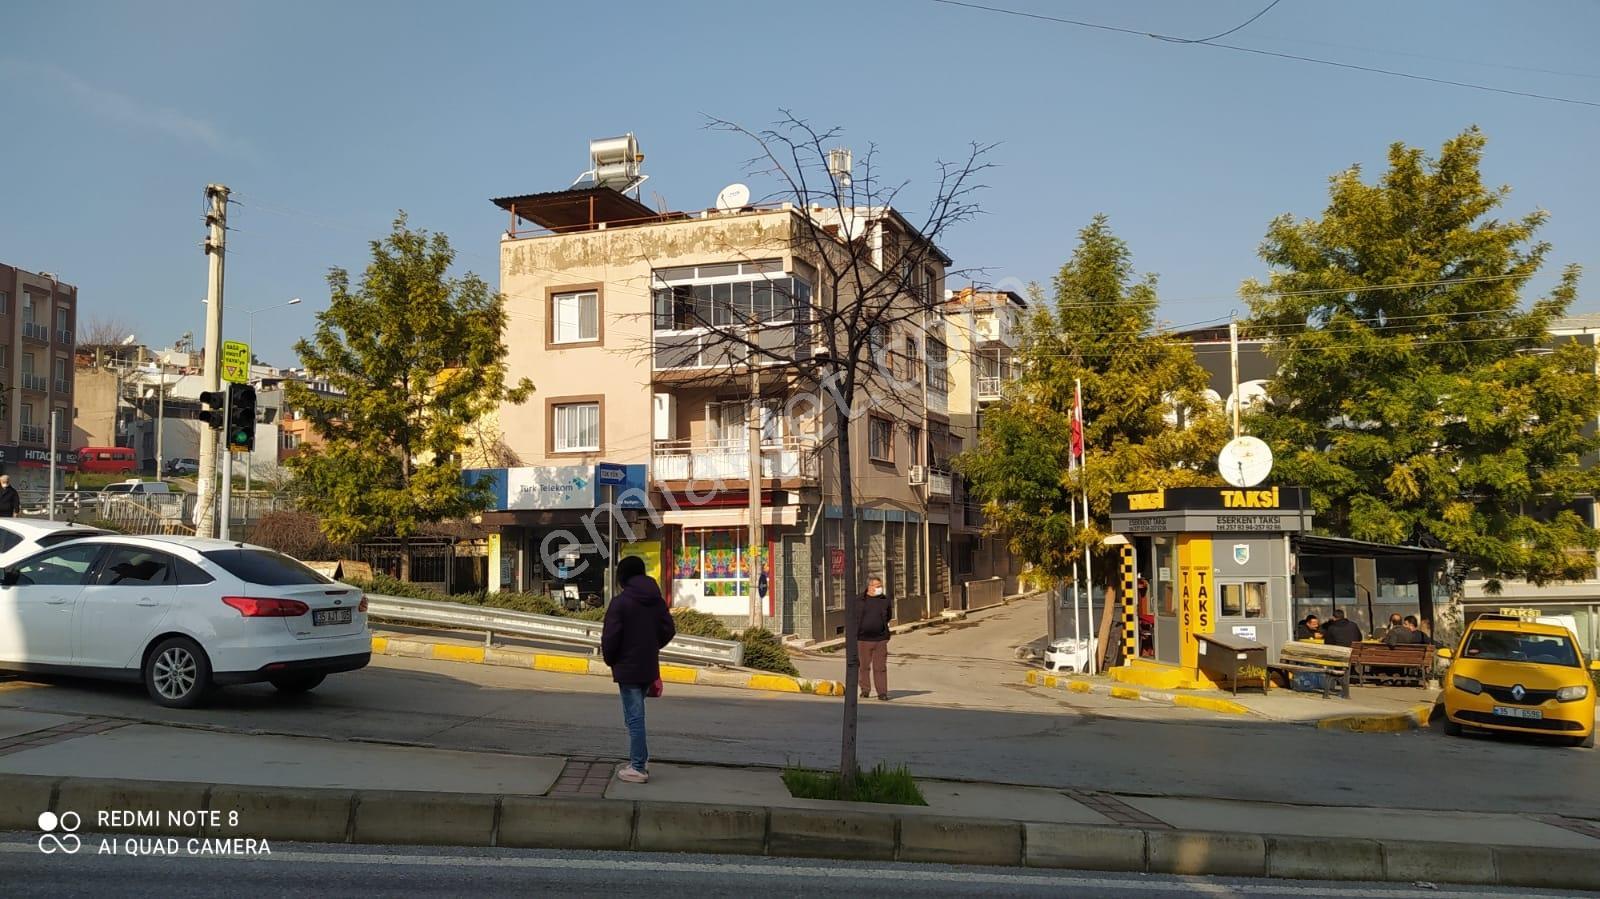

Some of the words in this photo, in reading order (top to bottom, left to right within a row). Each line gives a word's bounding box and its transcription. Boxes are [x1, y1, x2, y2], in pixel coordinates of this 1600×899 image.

[540, 483, 573, 492] Telekom
[1221, 486, 1279, 507] TAKSİ
[1216, 516, 1256, 524] ESERKENT
[1198, 571, 1208, 632] TAKS
